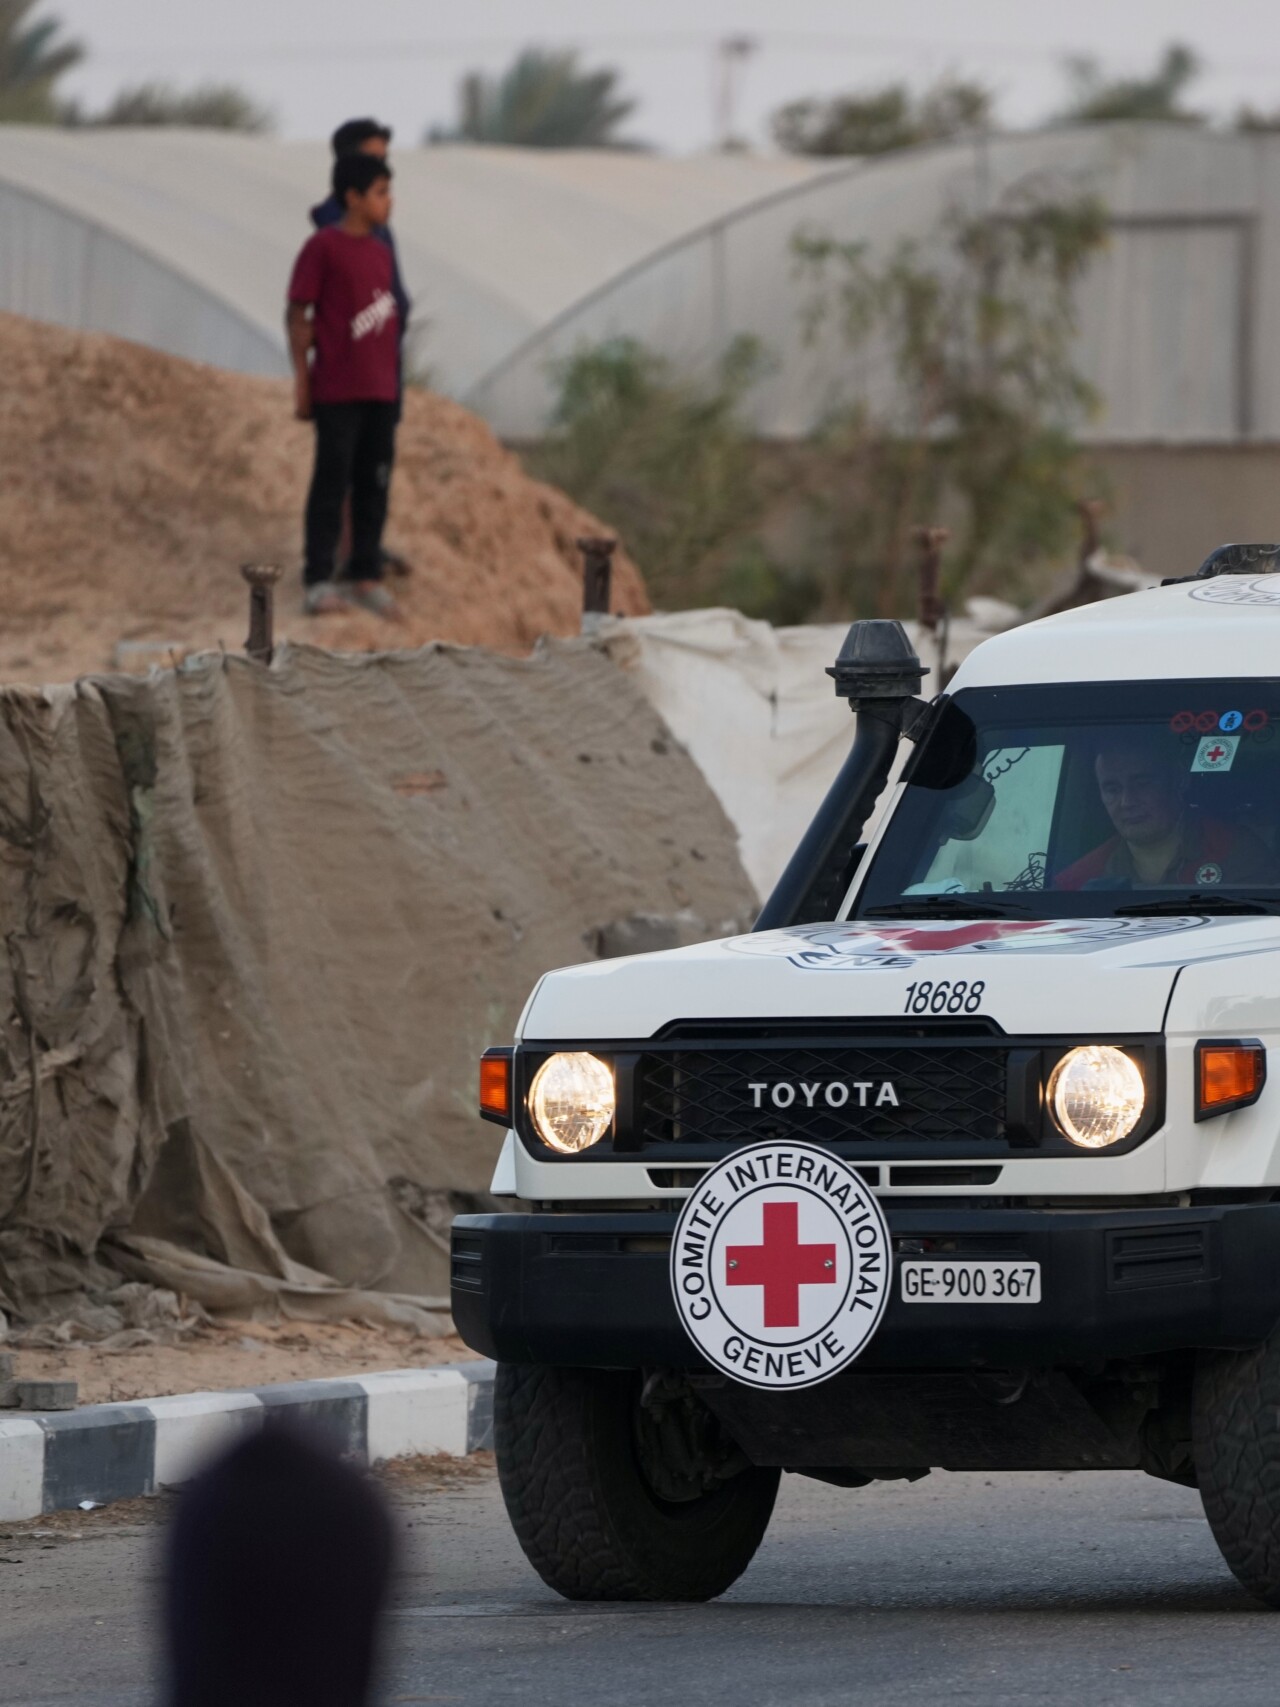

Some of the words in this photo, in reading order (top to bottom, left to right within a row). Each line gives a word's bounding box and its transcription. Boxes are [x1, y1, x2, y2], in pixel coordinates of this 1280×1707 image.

[903, 979, 986, 1014] 18688
[748, 1081, 900, 1109] TOYOTA
[682, 1189, 725, 1321] COMITE
[724, 1152, 881, 1314] INTERNATIONAL
[722, 1330, 845, 1378] GENEVE
